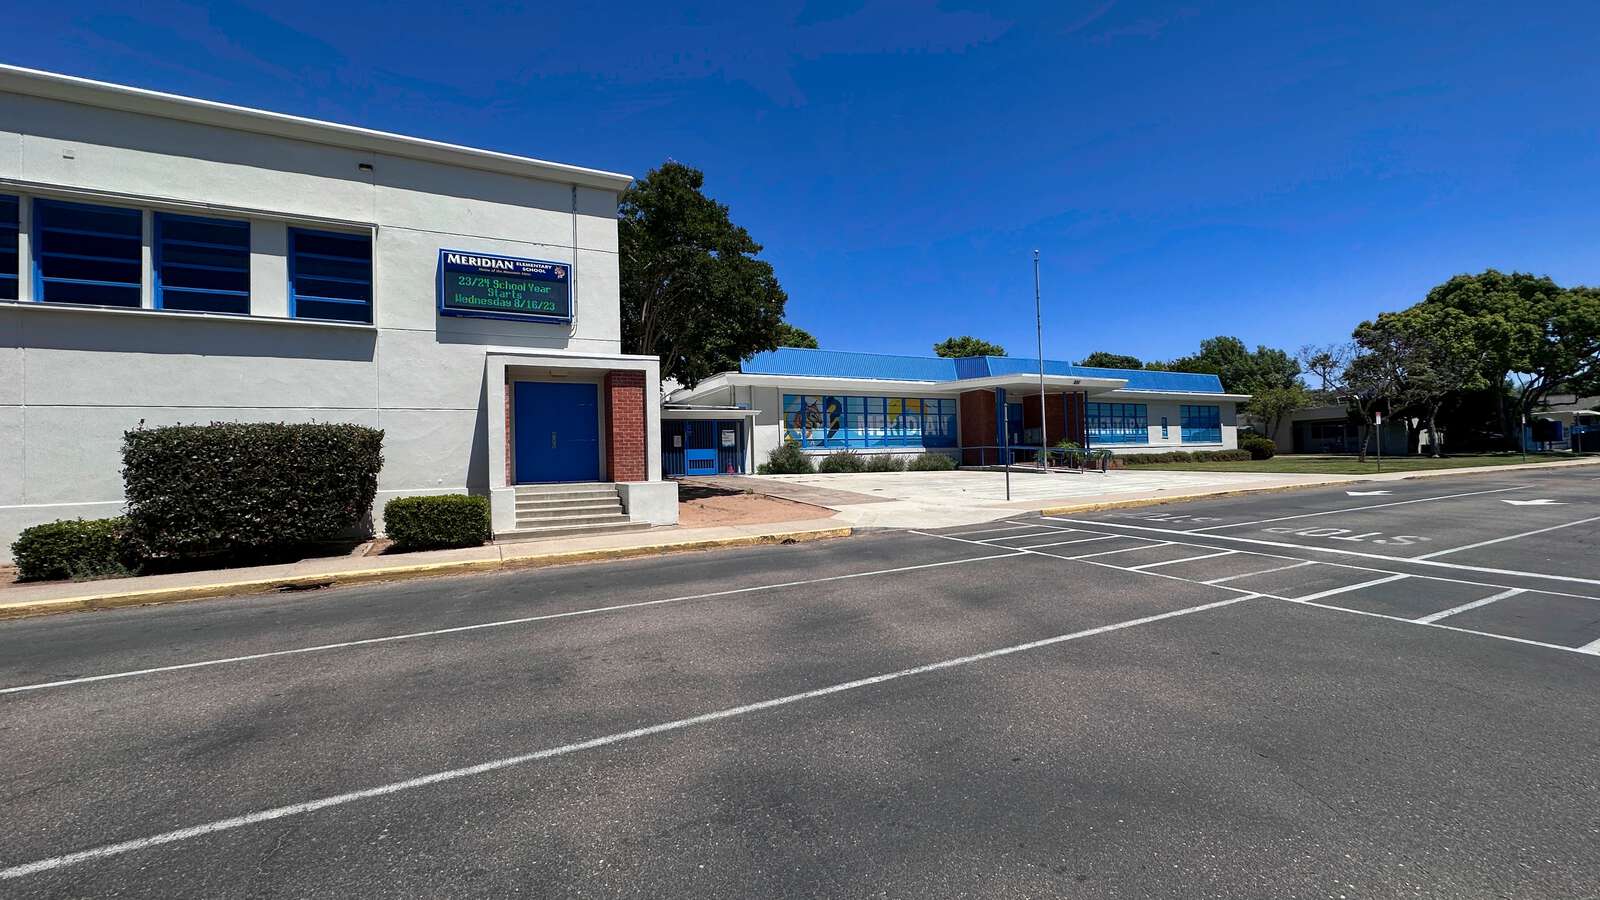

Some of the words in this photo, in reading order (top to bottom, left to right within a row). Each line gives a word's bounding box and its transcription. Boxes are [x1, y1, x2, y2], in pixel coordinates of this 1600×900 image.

[447, 254, 514, 270] MERIDIAN
[515, 261, 552, 269] ELEMENTARY
[458, 276, 490, 287] 23/24
[493, 279, 526, 291] School
[528, 283, 552, 293] Year
[487, 288, 522, 299] Starts
[455, 294, 512, 307] Wednesday
[514, 298, 555, 311] 8/16/23
[1262, 526, 1432, 546] STOP
